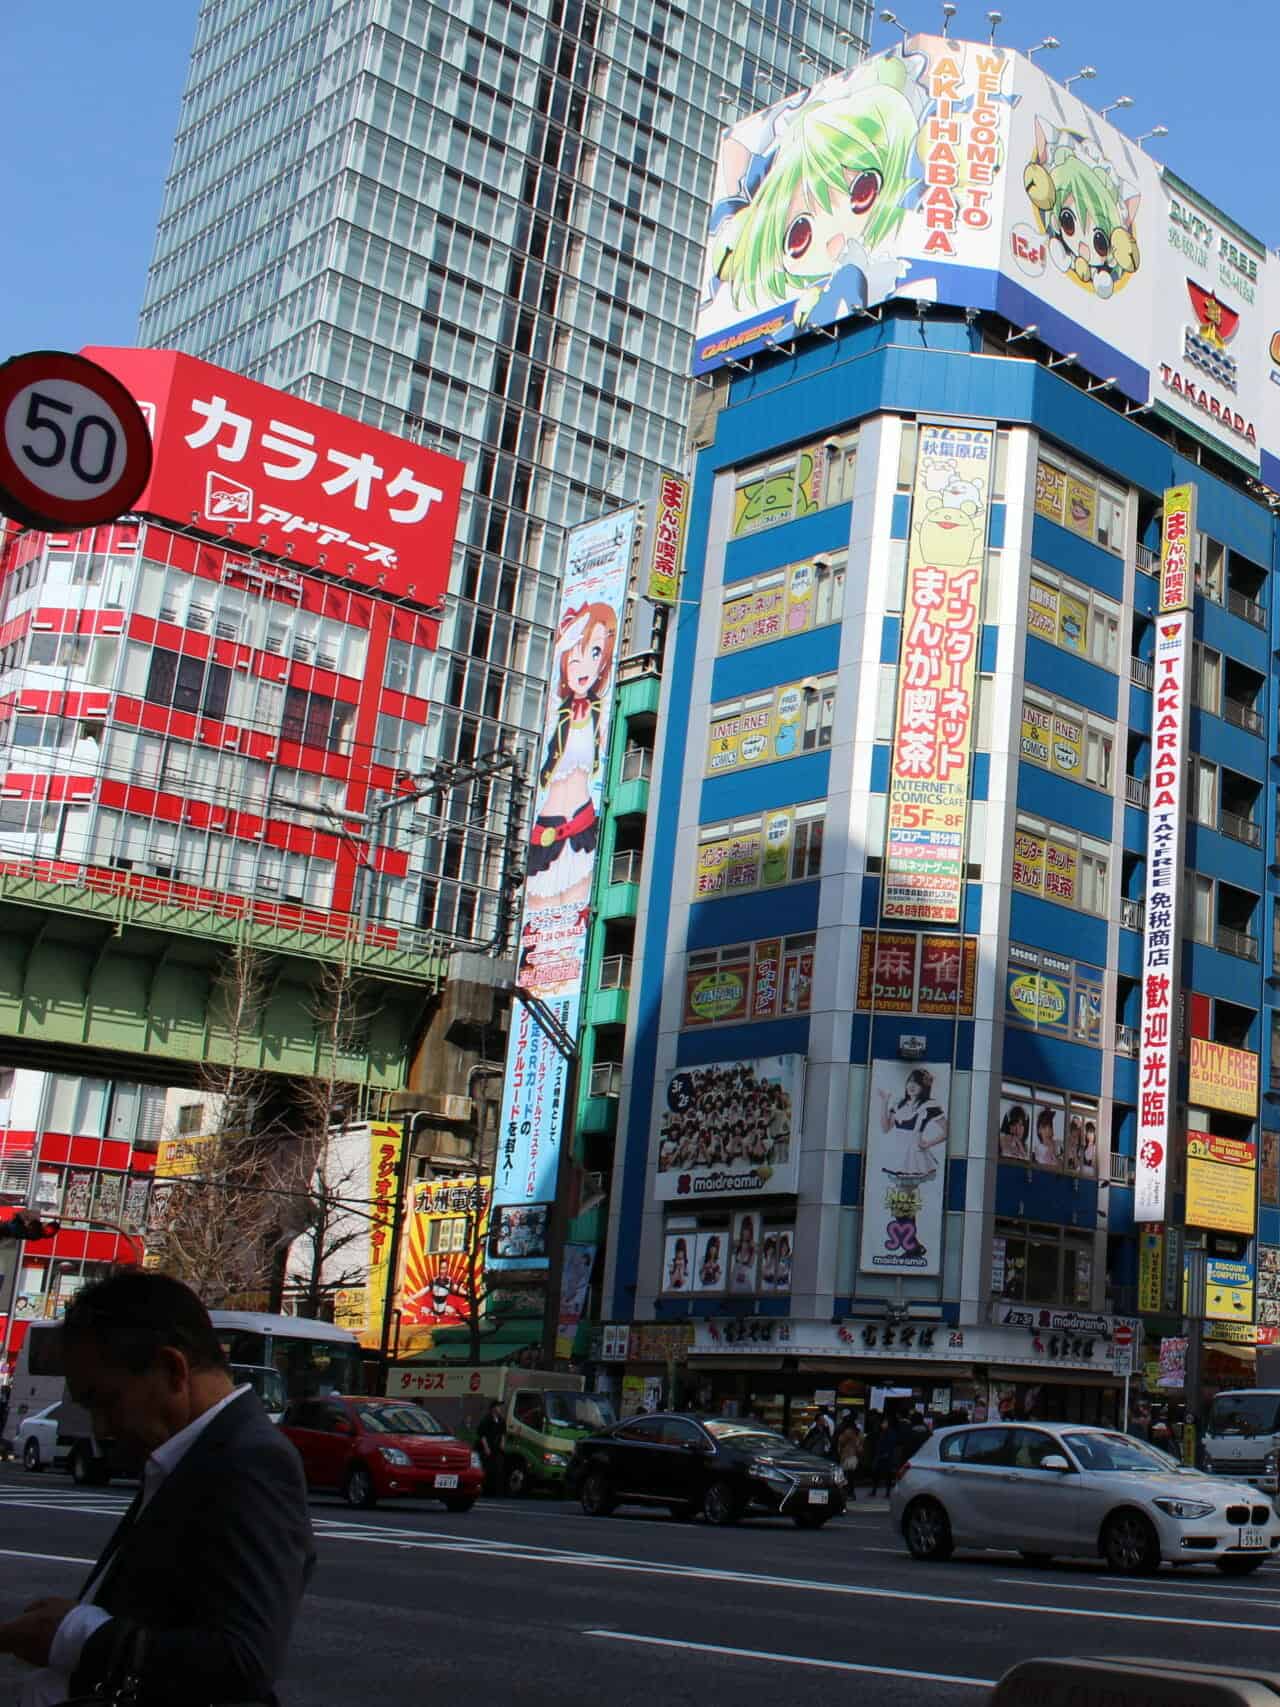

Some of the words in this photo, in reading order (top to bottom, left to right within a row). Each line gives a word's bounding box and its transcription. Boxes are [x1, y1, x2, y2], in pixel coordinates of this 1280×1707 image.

[923, 56, 961, 254] AKIHABARA
[1218, 238, 1258, 283] FREE
[21, 391, 117, 485] 50
[1160, 363, 1257, 447] TAKARADA
[184, 395, 443, 524] カラオケ
[257, 502, 398, 569] アドアーズ
[1164, 510, 1186, 606] まんが喫茶
[895, 568, 947, 777] まんが喫茶
[936, 570, 977, 777] インターネット
[1022, 708, 1080, 742] INTERNET
[1153, 656, 1180, 808] TAKARADA
[893, 779, 955, 795] INTERNET
[893, 791, 943, 806] COMICS
[1013, 862, 1074, 898] まんが喫茶
[1014, 837, 1076, 870] インターネット
[1146, 891, 1173, 967] 免税商店
[1191, 1039, 1226, 1074] DUTY
[1227, 1046, 1257, 1083] FREE
